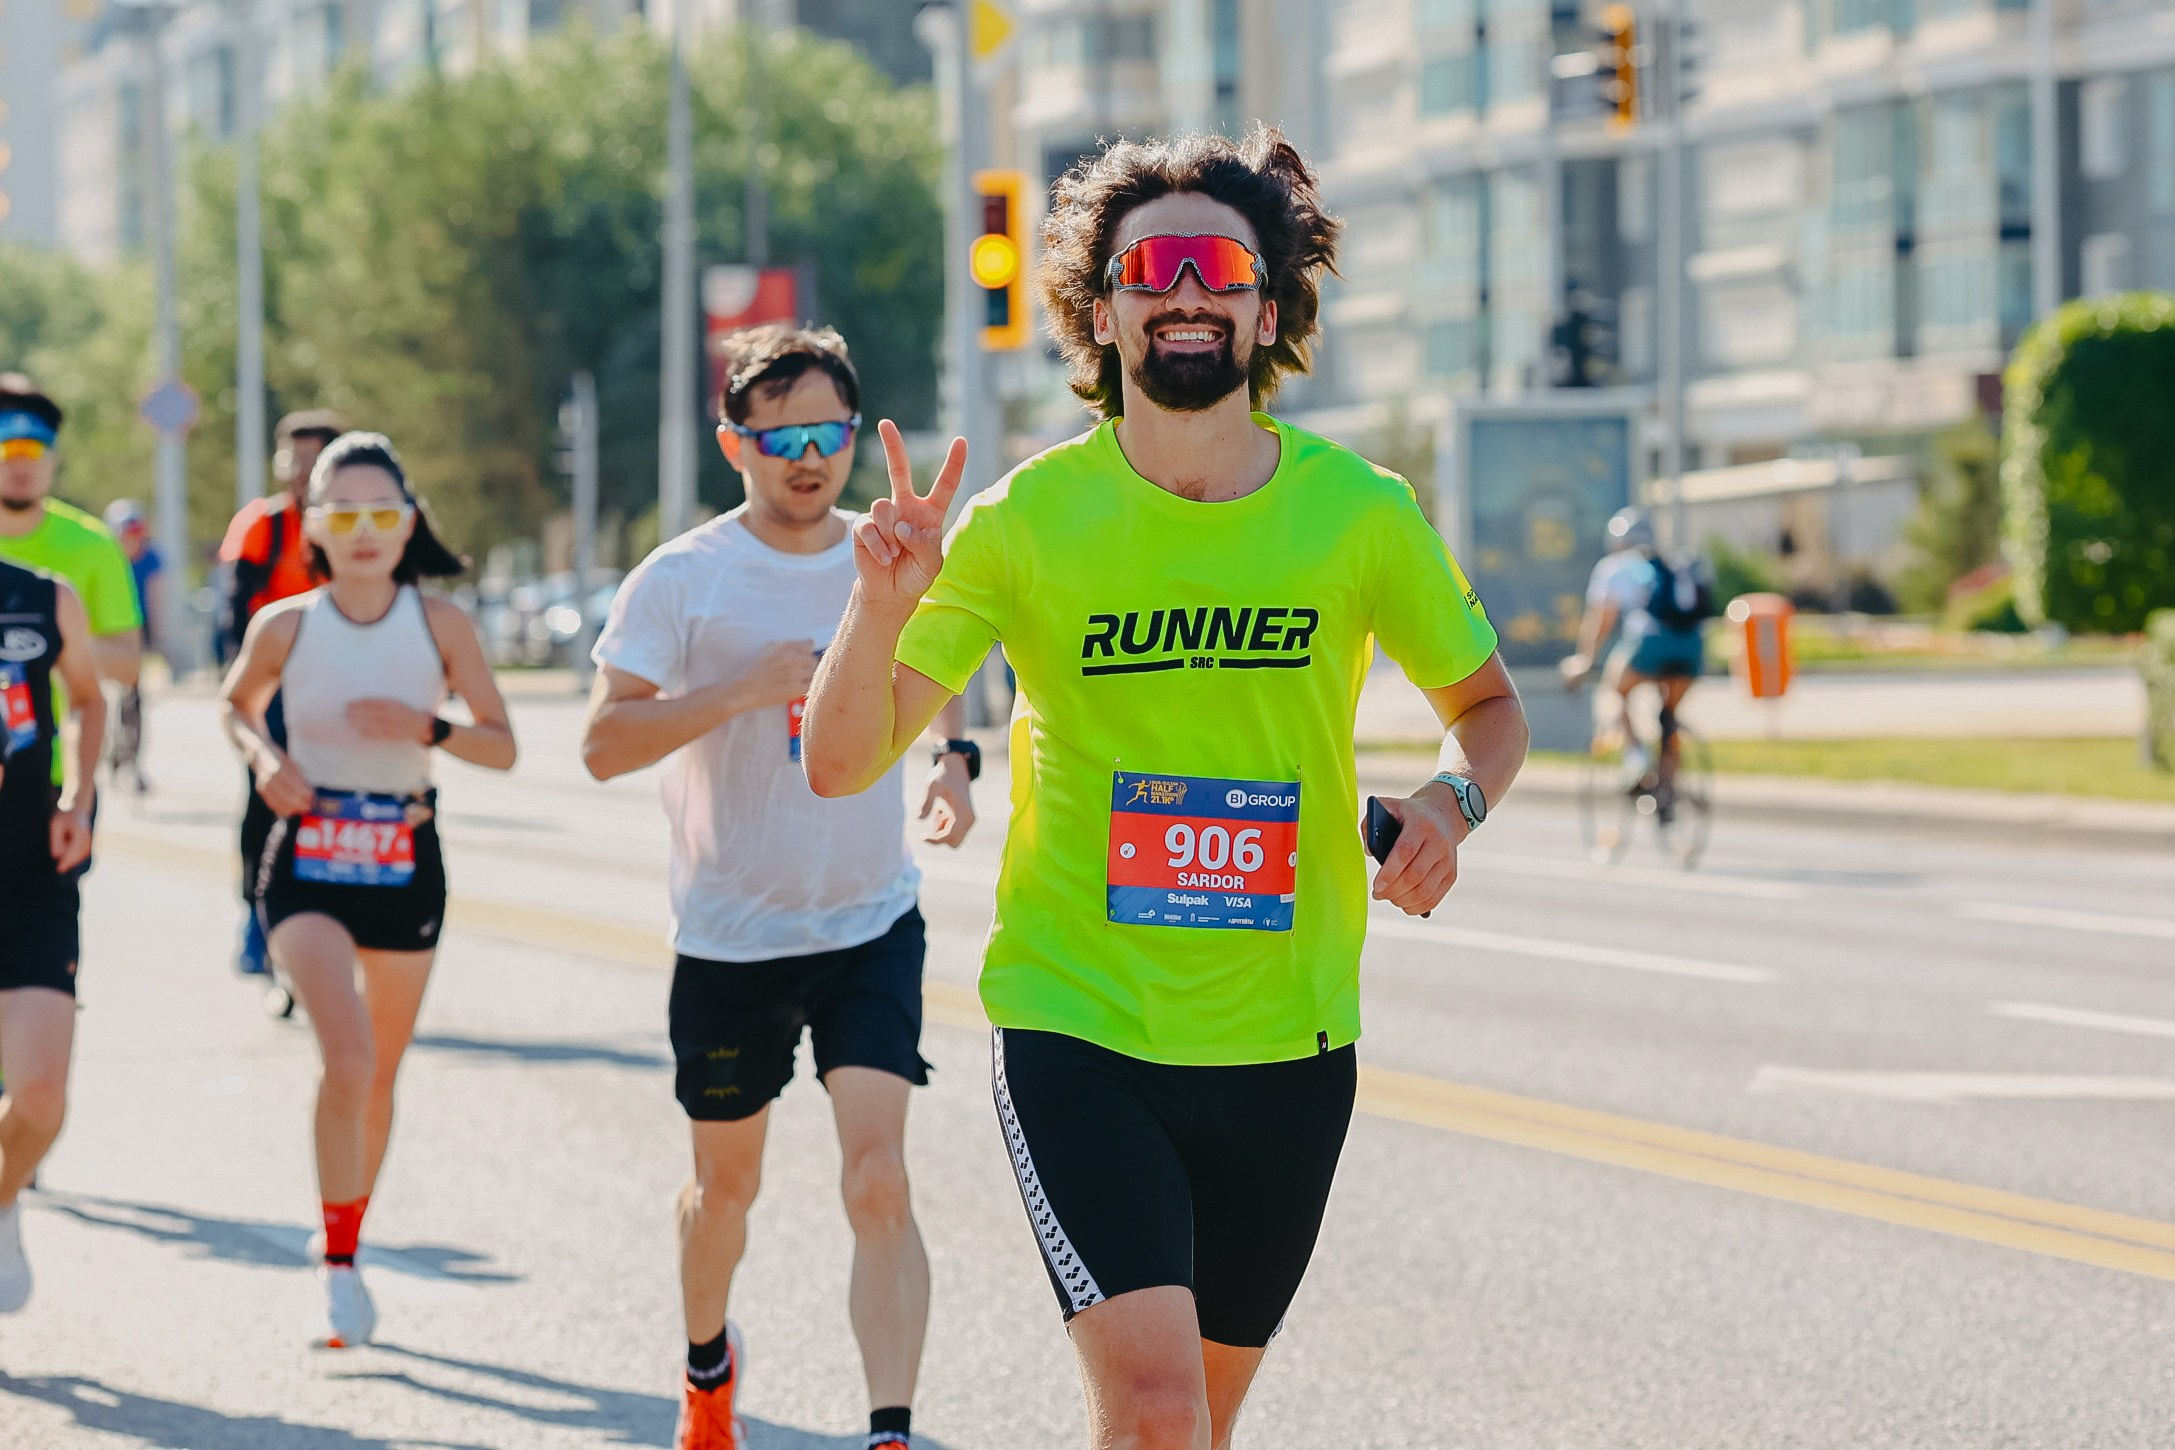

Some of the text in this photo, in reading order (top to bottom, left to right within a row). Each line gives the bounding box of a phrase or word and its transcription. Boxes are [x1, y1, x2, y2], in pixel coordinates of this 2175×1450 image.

[1081, 607, 1319, 659] RUNNER
[1189, 656, 1215, 669] SRC
[1151, 784, 1174, 792] HALF
[1248, 794, 1296, 807] GROUP
[1164, 823, 1265, 872] 906
[1176, 872, 1245, 890] SARDOR
[1167, 893, 1252, 908] Sulpak VISA
